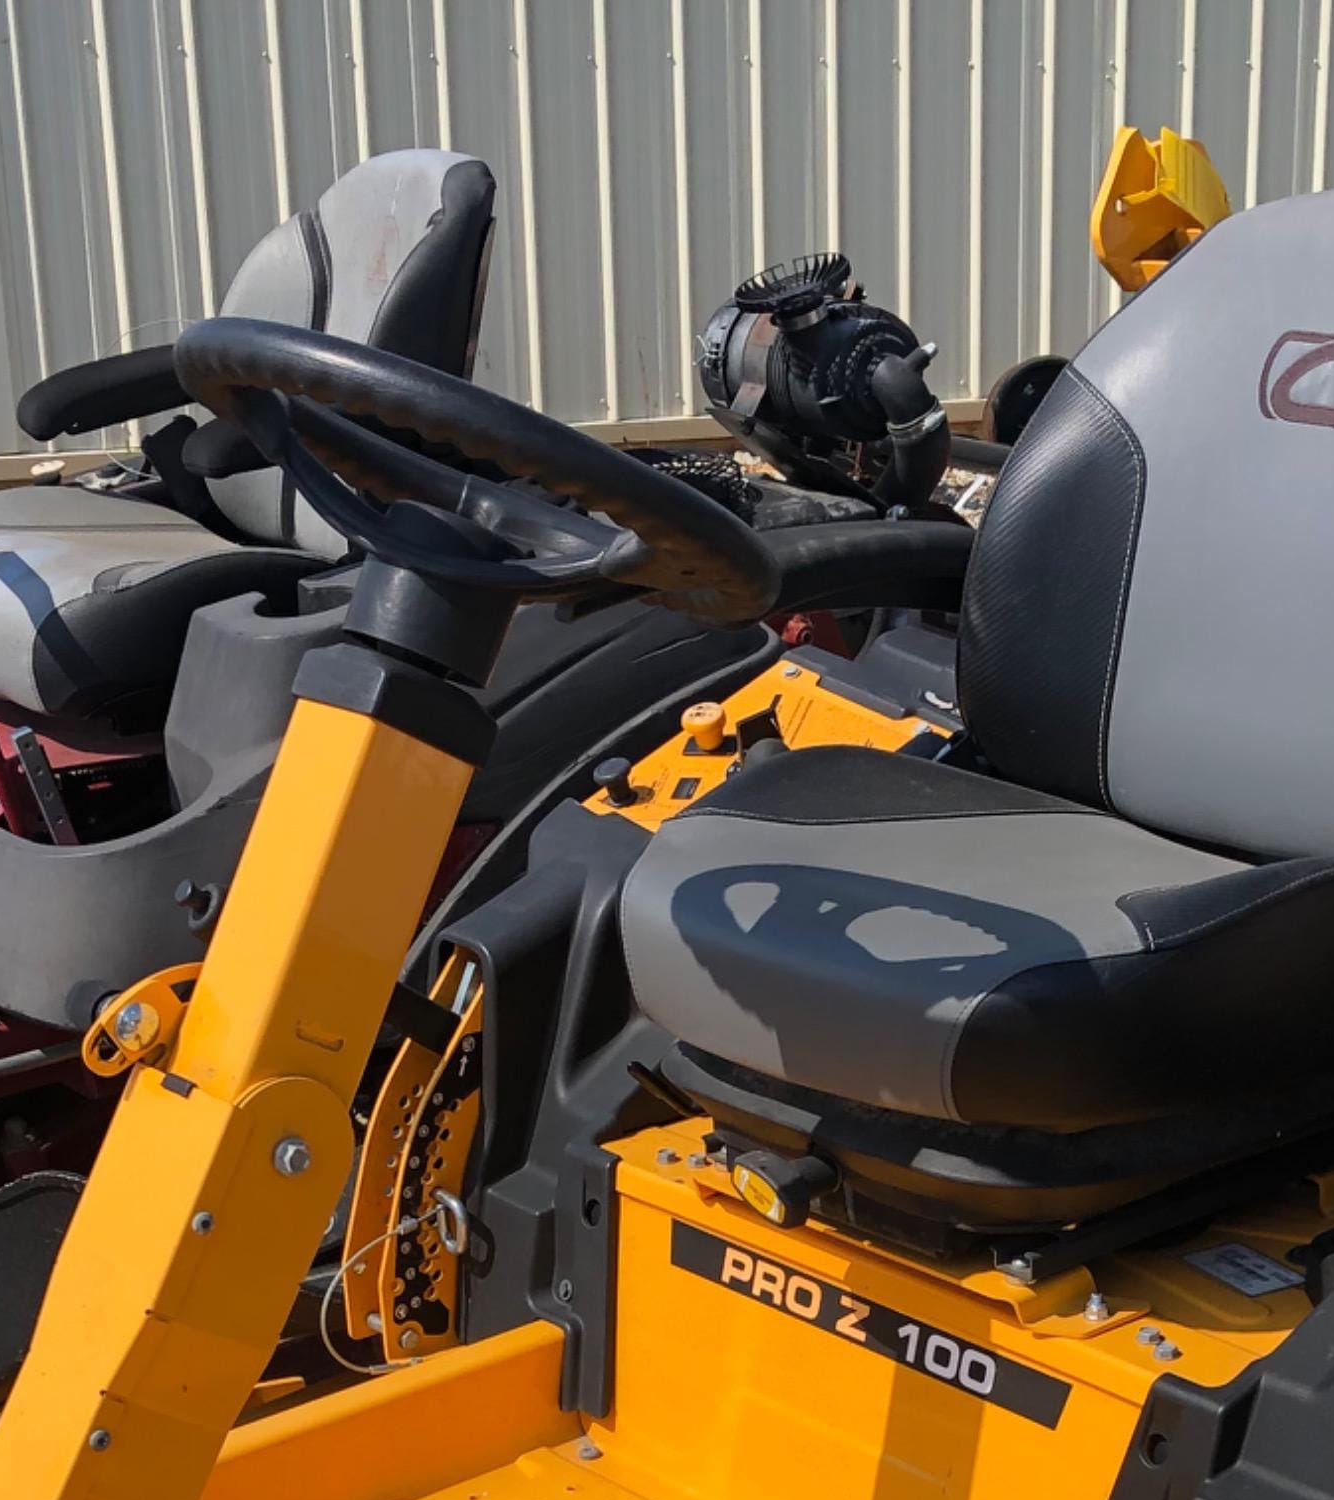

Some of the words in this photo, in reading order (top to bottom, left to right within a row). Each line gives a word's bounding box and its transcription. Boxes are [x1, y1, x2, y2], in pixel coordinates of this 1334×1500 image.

[721, 1247, 822, 1320] PRO
[835, 1294, 870, 1343] Z
[897, 1323, 996, 1395] 100
